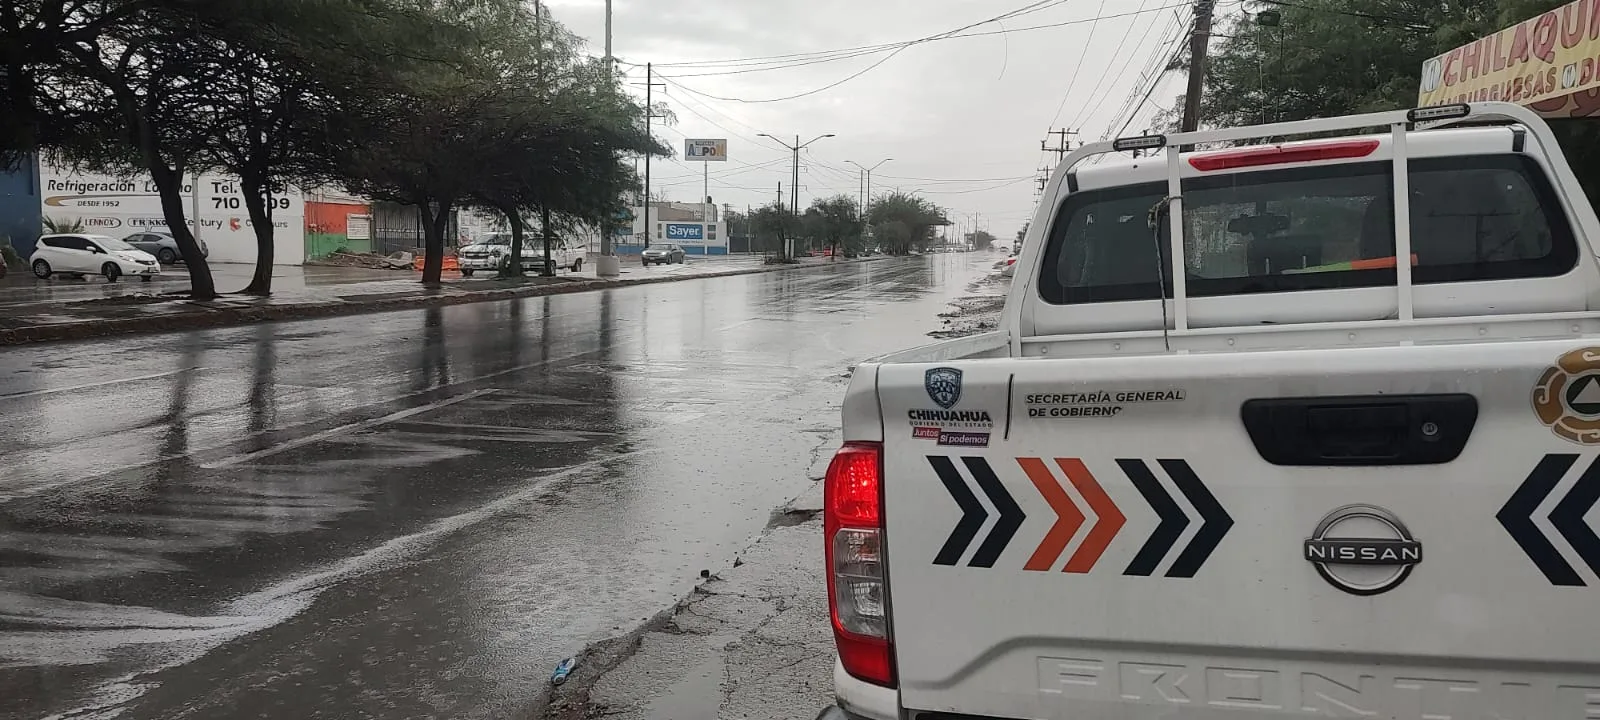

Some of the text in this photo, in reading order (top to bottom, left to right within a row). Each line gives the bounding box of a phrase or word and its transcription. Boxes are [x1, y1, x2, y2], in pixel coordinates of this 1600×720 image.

[48, 180, 136, 194] Refrigeración
[211, 181, 238, 194] Tel.
[211, 197, 240, 209] 710
[669, 225, 700, 236] Sayer
[1026, 390, 1183, 404] SECRETARÍA GENERAL
[908, 409, 992, 422] CHIHUAHUA
[1028, 408, 1046, 417] DE
[914, 428, 939, 437] Juntos
[949, 434, 987, 445] podemos
[1308, 544, 1419, 560] NISSAN
